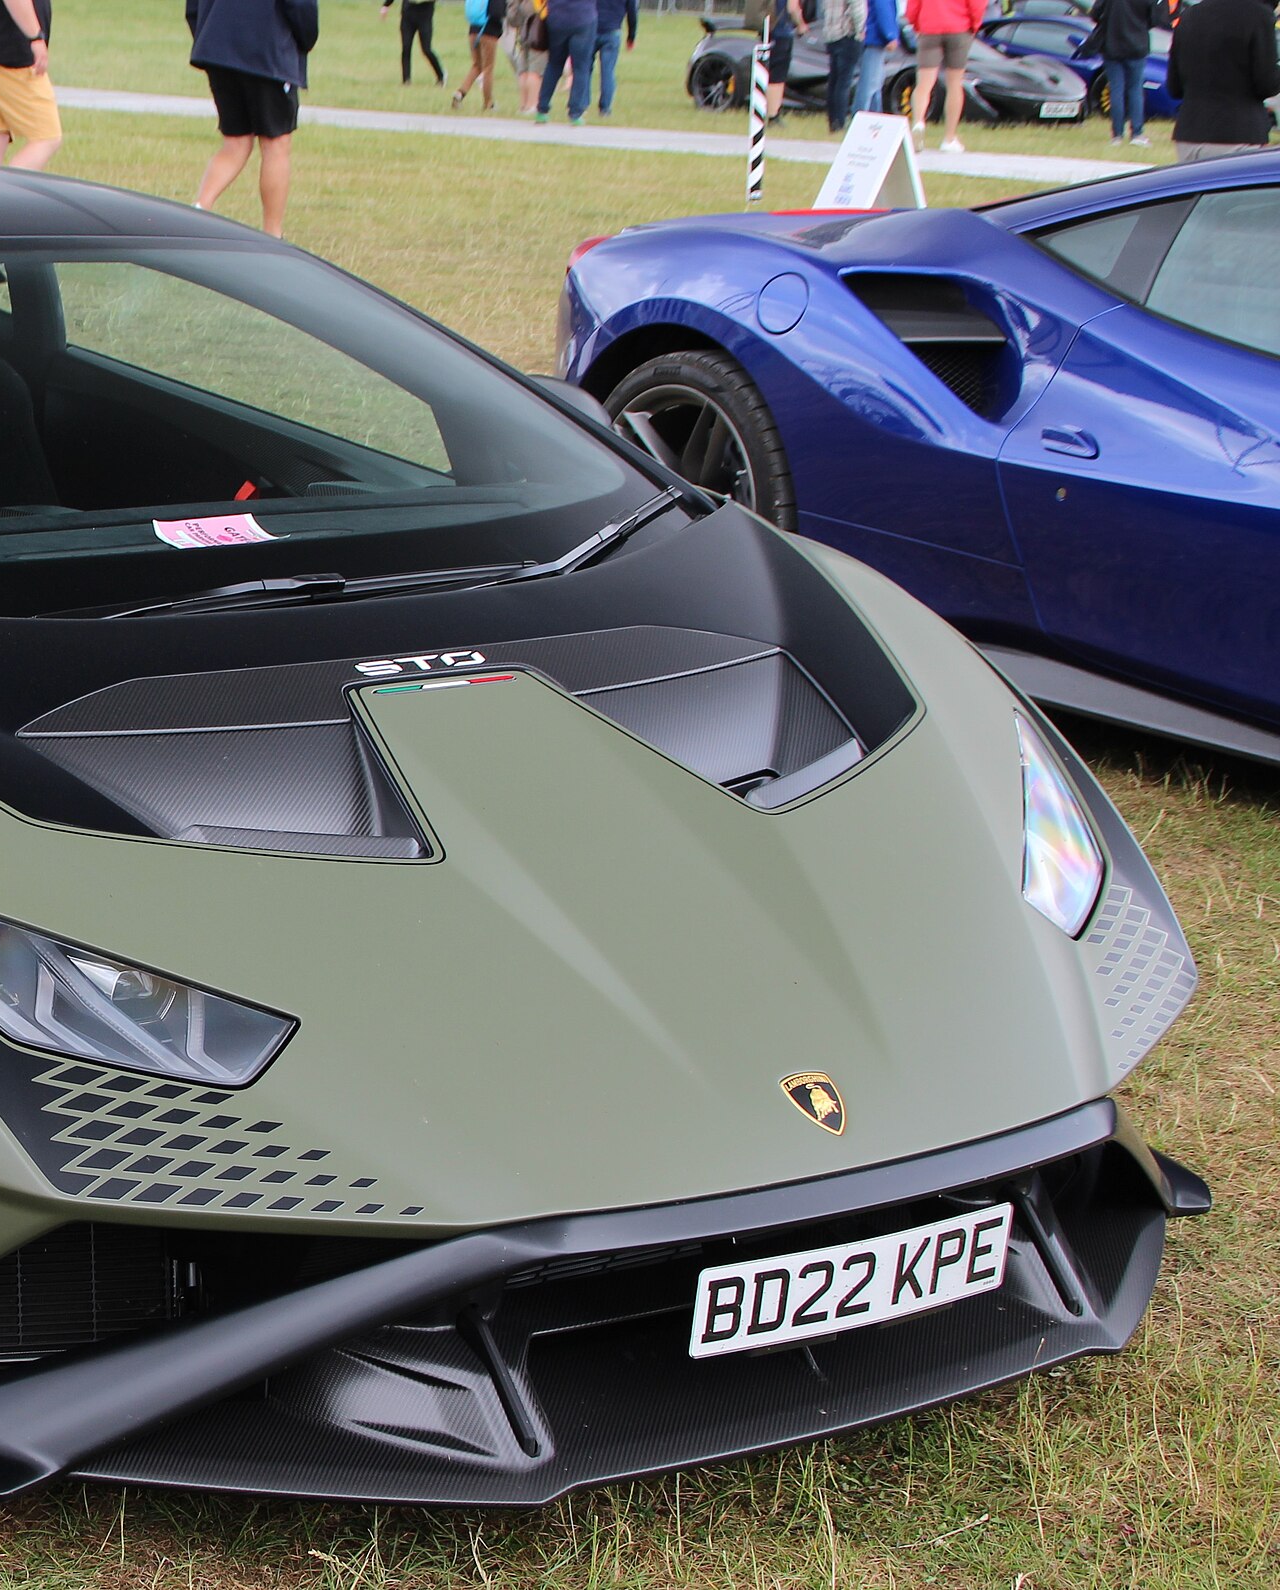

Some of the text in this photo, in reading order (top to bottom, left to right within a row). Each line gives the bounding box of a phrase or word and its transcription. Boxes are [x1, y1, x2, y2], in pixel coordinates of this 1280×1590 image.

[354, 650, 487, 676] STO
[701, 1216, 1004, 1344] BD22 KPE
